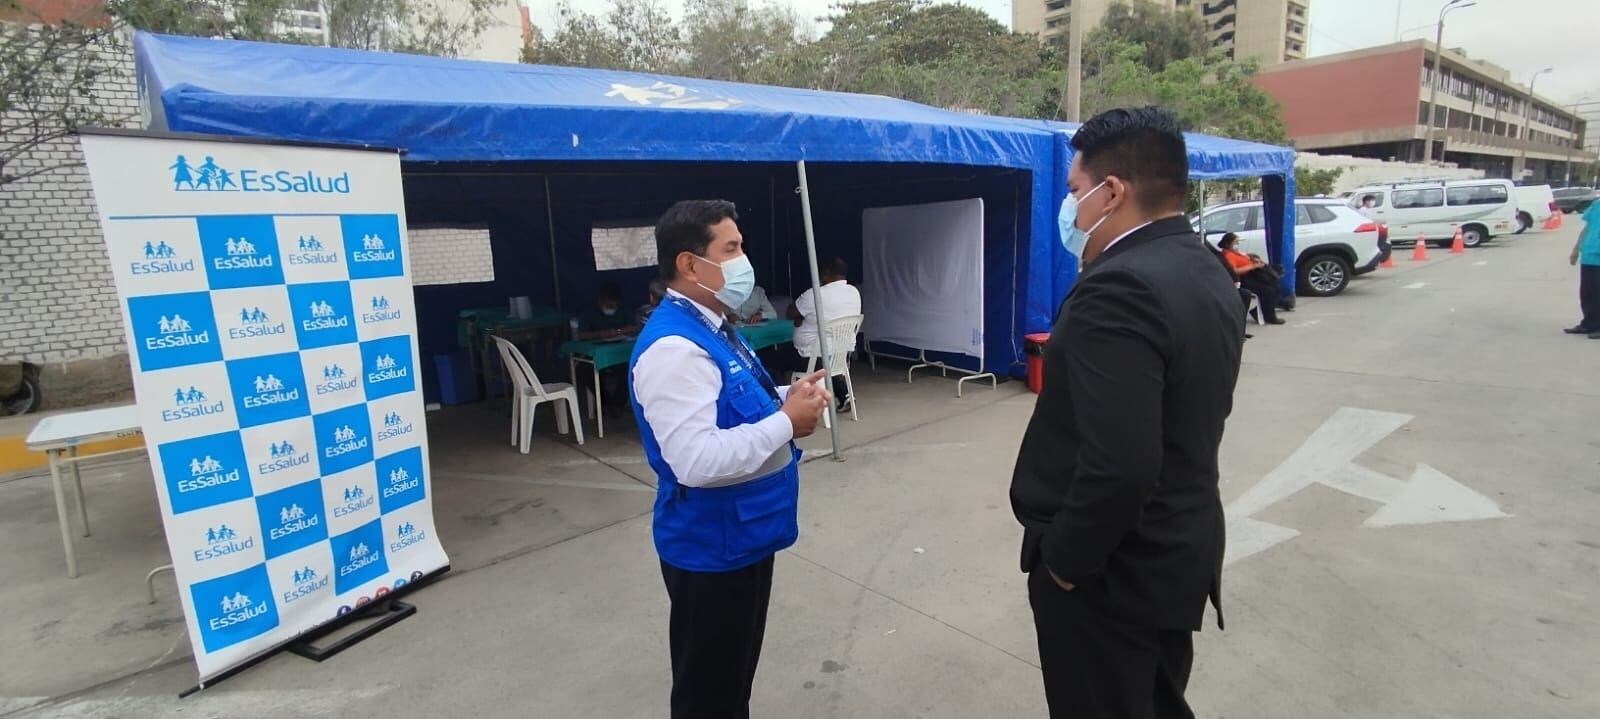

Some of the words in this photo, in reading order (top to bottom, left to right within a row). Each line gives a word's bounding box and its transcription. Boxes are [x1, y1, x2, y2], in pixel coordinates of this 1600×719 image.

[241, 170, 349, 193] EsSalud
[214, 255, 273, 270] EsSalud
[289, 252, 337, 265] EsSalud
[353, 249, 394, 262] EsSalud
[131, 259, 194, 275] EsSalud
[303, 316, 348, 331] EsSalud
[363, 309, 401, 324] EsSalud
[146, 331, 209, 350] EsSalud
[229, 323, 285, 340] EsSalud
[369, 366, 406, 384] EsSalud
[316, 377, 357, 395] EsSalud
[243, 389, 299, 409] EsSalud
[162, 402, 224, 422] EsSalud
[377, 423, 413, 441] EsSalud
[325, 437, 367, 458] EsSalud
[258, 452, 309, 475] EsSalud
[178, 469, 240, 493] EsSalud
[383, 477, 418, 498] EsSalud
[333, 496, 374, 518] EsSalud
[270, 514, 318, 540] EsSalud
[194, 536, 253, 562] EsSalud
[390, 531, 425, 552] EsSalud
[340, 551, 379, 577] EsSalud
[283, 576, 328, 603] EsSalud
[210, 600, 267, 631] EsSalud
